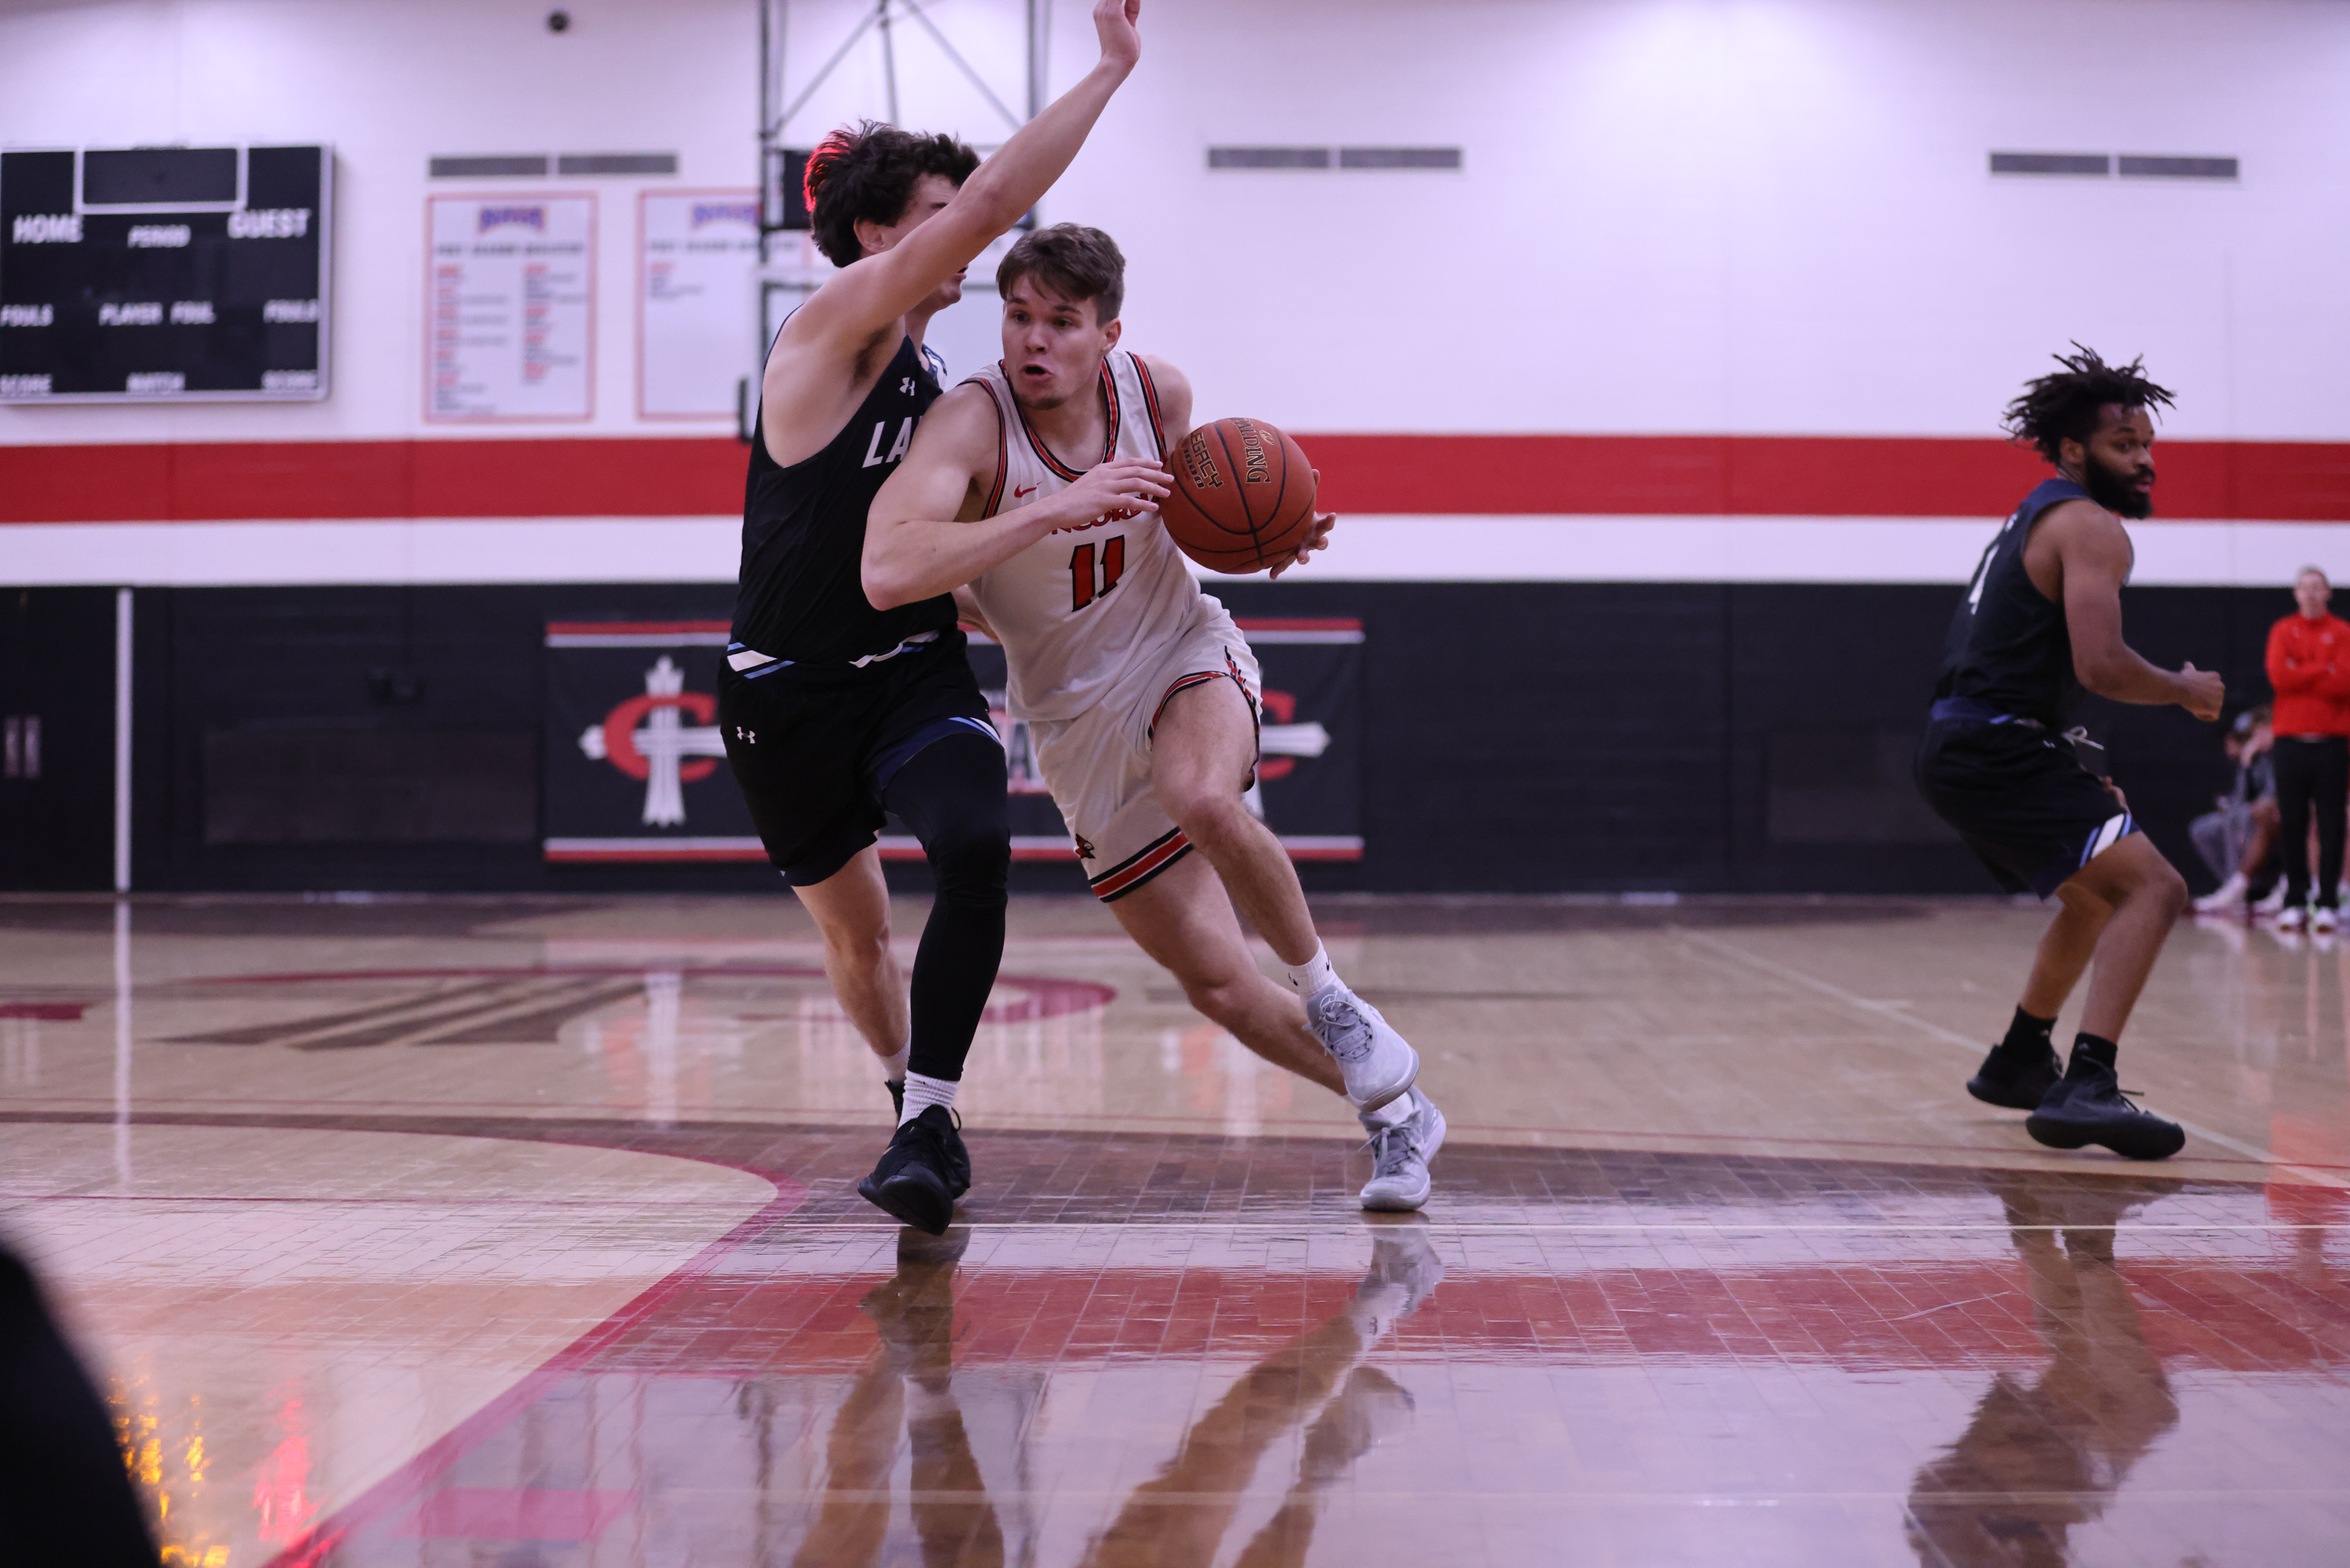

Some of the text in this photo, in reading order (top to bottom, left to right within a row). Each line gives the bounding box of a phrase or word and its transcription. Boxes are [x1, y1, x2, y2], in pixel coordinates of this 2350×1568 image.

[13, 213, 84, 244] HOME
[227, 207, 311, 240] GUEST
[0, 303, 54, 328] FOULS
[98, 301, 163, 326] PLAYER
[862, 416, 913, 468] LA
[1190, 431, 1225, 489] EGACY
[1069, 534, 1126, 613] 11
